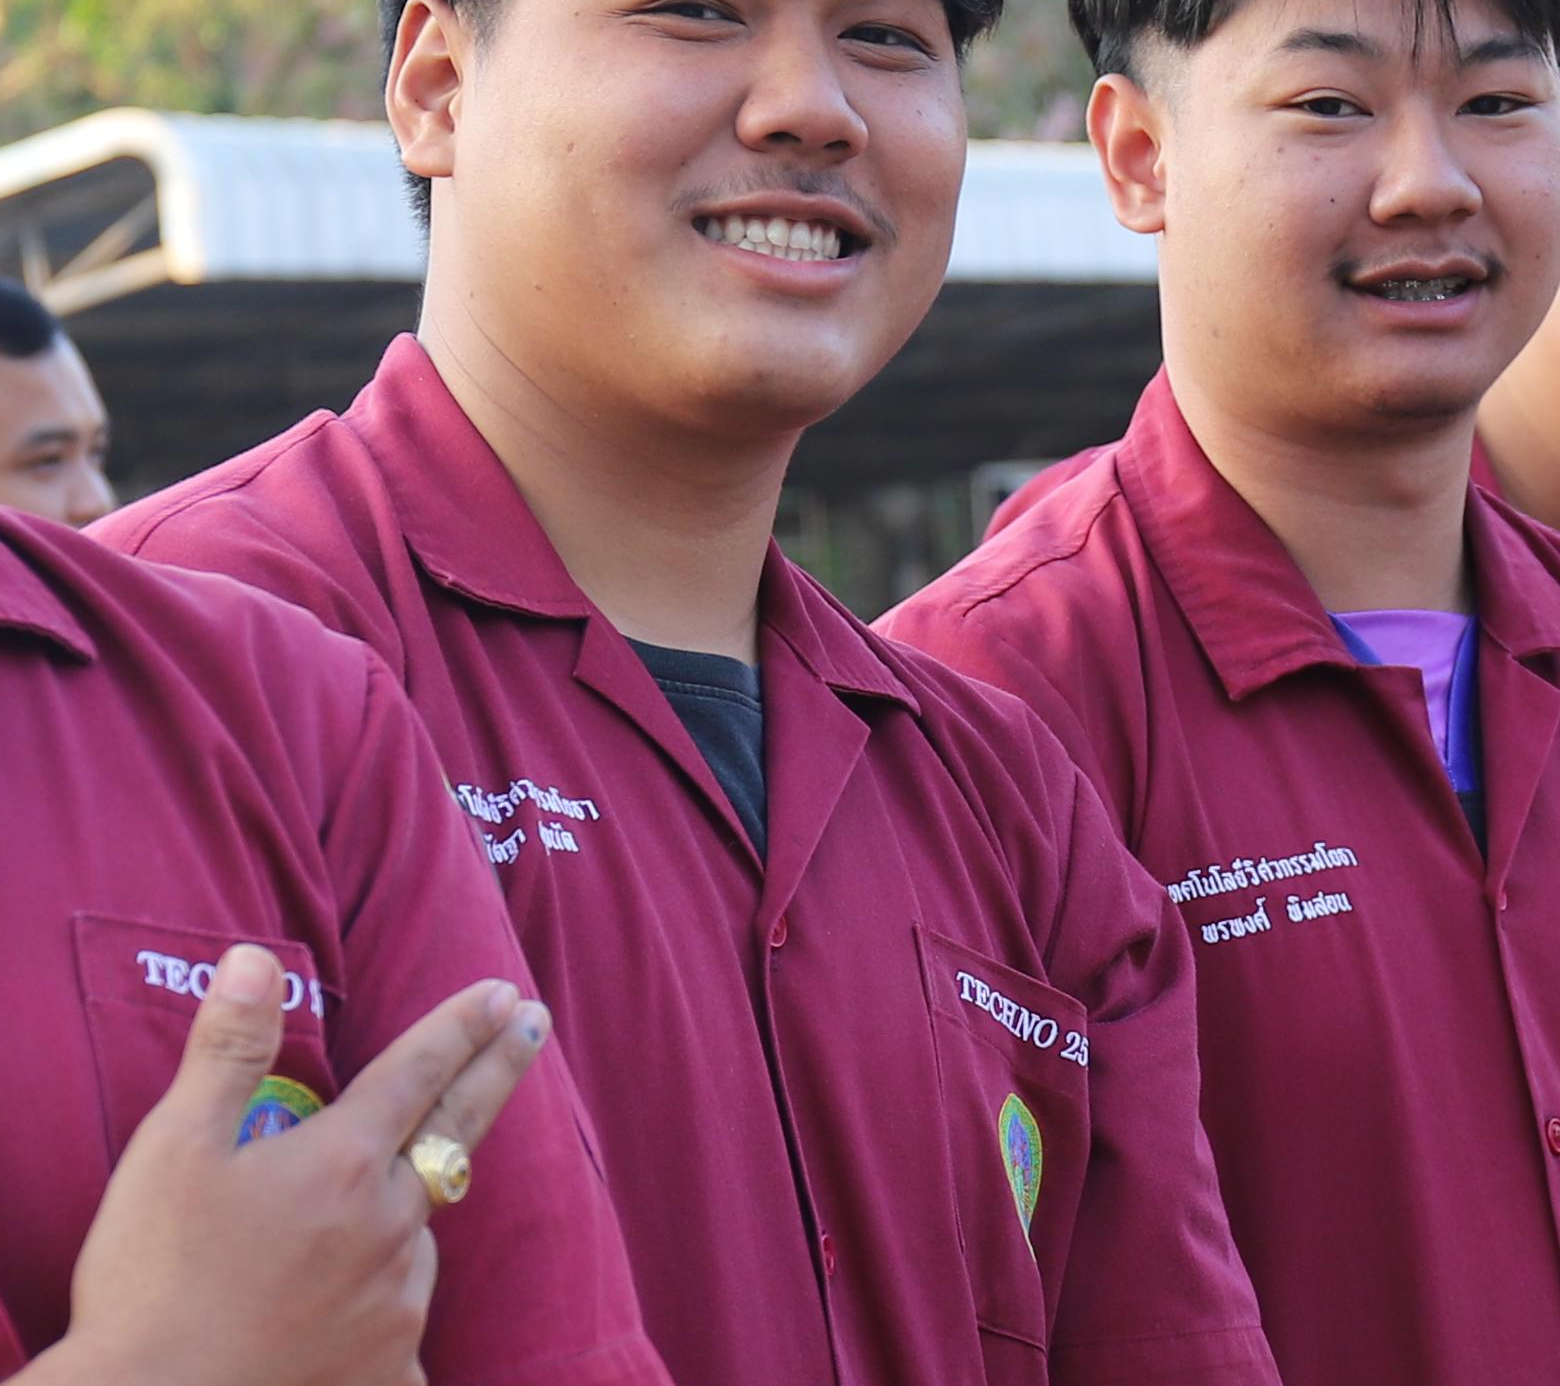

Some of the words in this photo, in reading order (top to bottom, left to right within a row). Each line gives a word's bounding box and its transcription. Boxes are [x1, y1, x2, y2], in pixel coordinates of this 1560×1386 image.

[1167, 842, 1358, 904] ทคโนโลยีวิศวกรรมโยธา
[136, 950, 304, 1011] TECO
[956, 971, 1058, 1049] TECHNO
